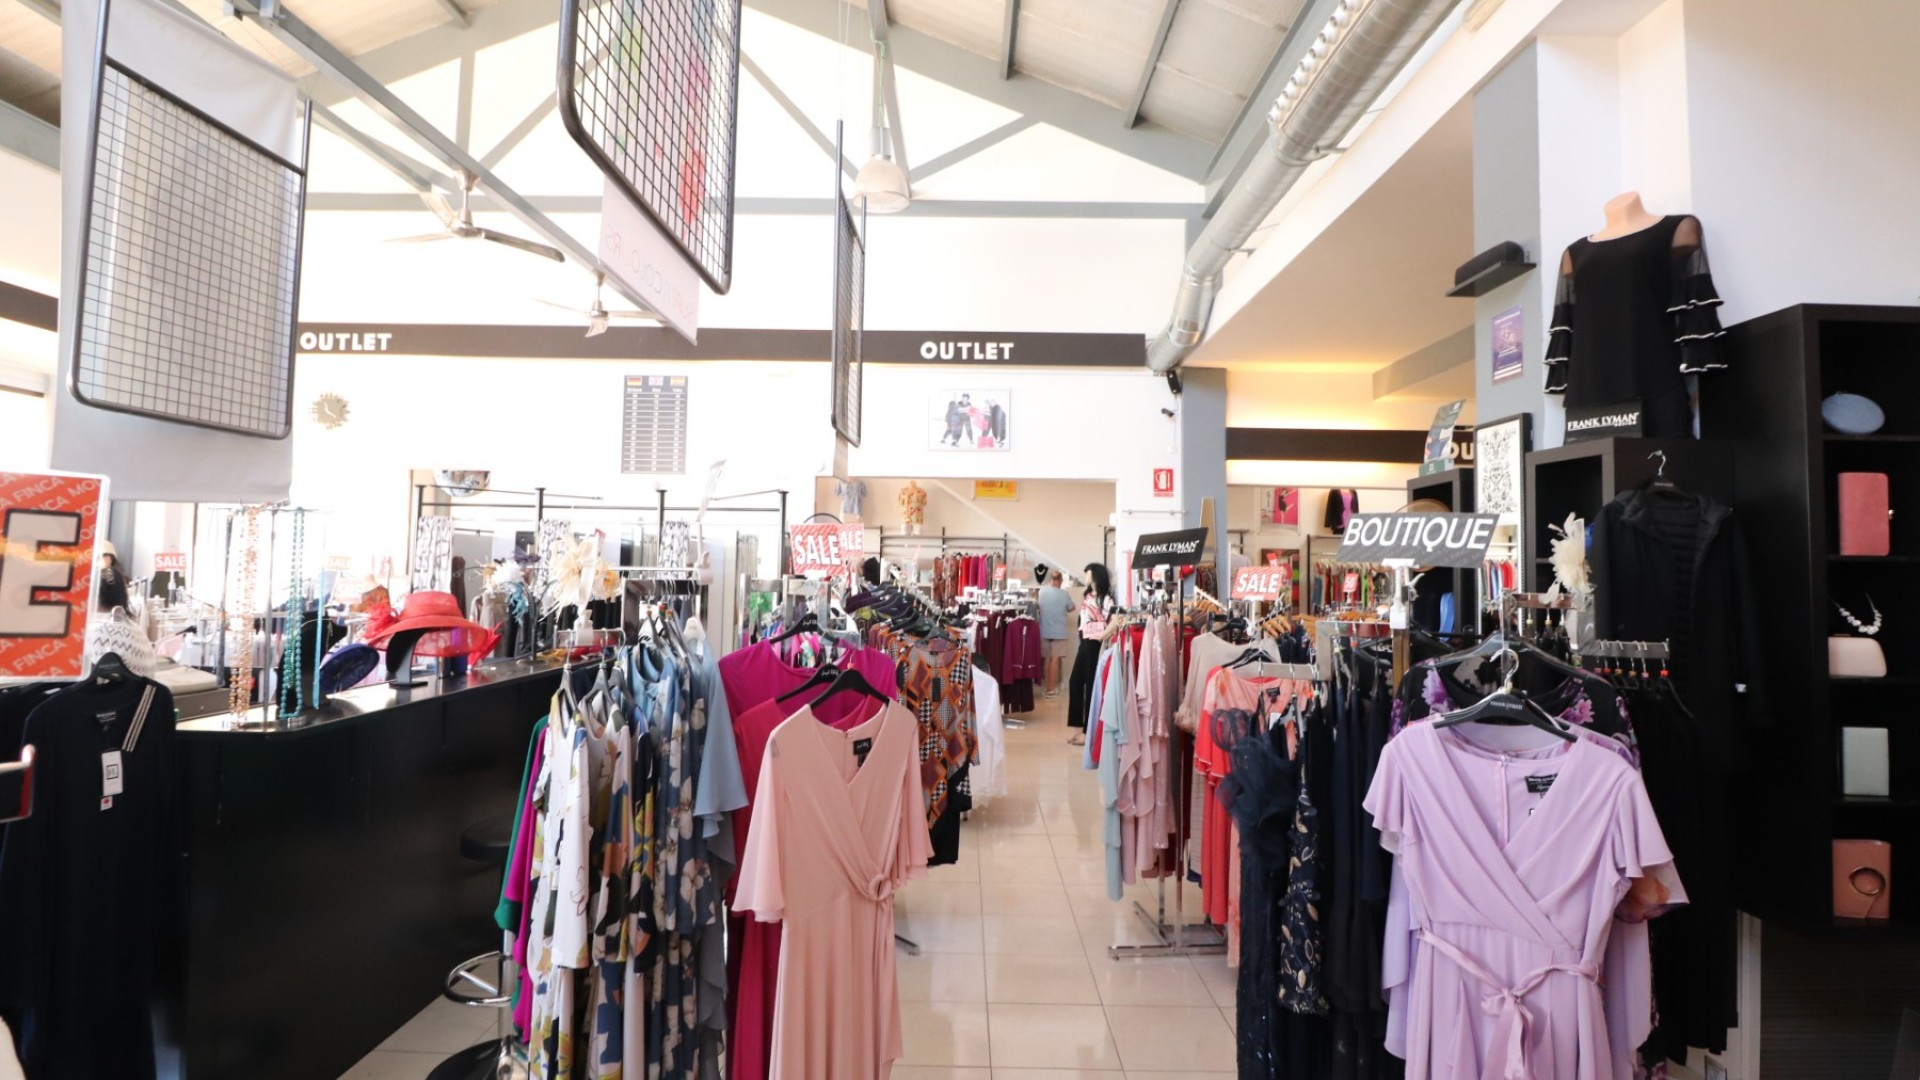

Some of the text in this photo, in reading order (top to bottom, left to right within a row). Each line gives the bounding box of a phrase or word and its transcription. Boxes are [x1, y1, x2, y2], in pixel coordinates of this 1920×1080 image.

[300, 332, 392, 351] OUTLET
[920, 341, 1014, 360] OUTLET
[1567, 411, 1638, 431] FRANK LYMAN
[1450, 442, 1474, 460] OU
[841, 530, 863, 551] ALE
[1343, 517, 1494, 552] BOUTIQUE
[795, 534, 841, 565] SALE
[1141, 540, 1196, 555] FRANK LYMAN
[156, 556, 186, 567] SALE
[1237, 573, 1279, 593] SALE
